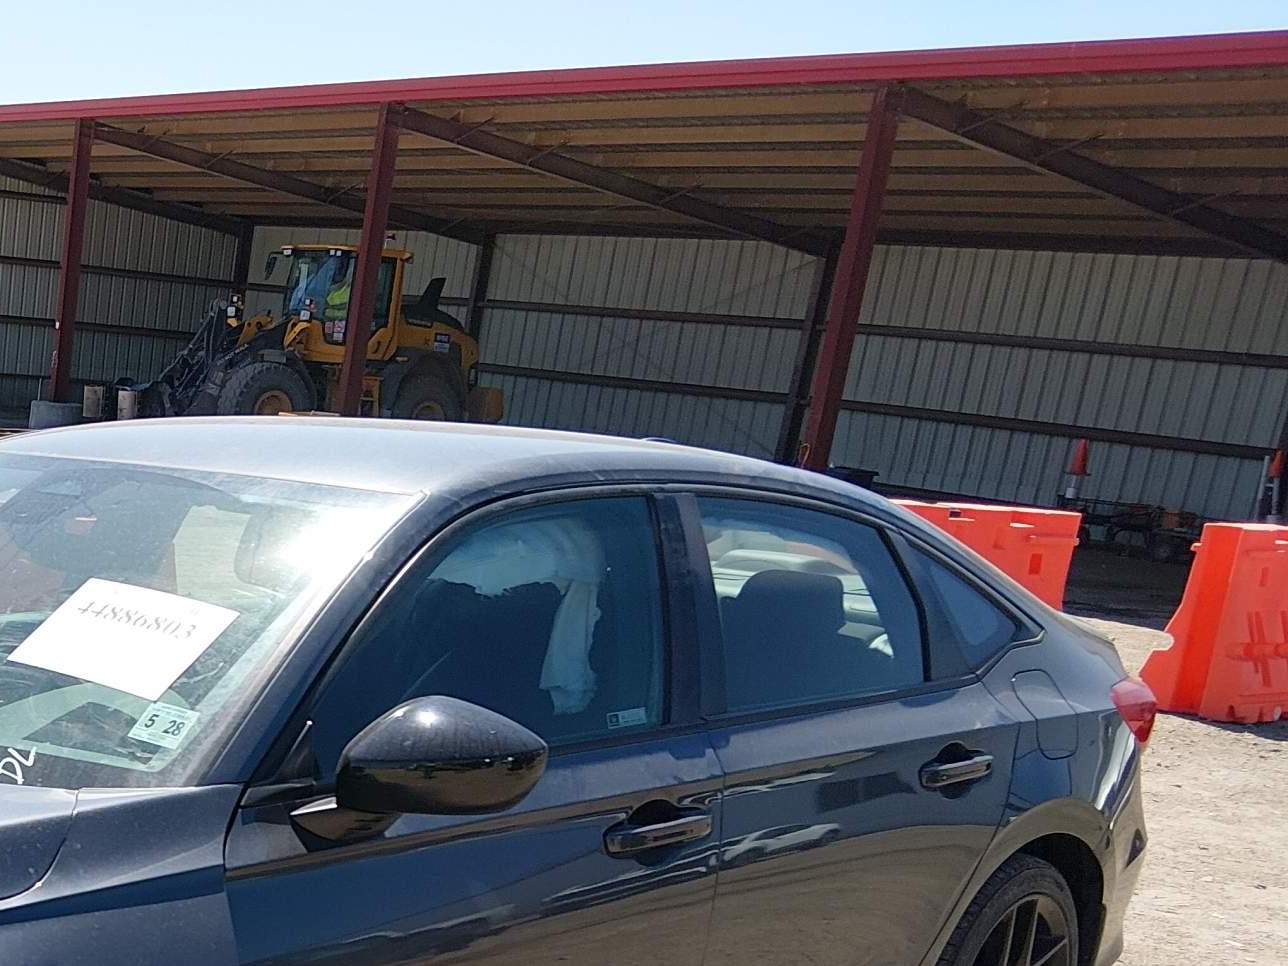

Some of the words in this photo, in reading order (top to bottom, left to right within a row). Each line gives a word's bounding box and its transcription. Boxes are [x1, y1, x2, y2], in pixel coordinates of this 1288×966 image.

[77, 600, 197, 640] 44886803
[144, 713, 160, 729] 5
[161, 719, 186, 737] 28
